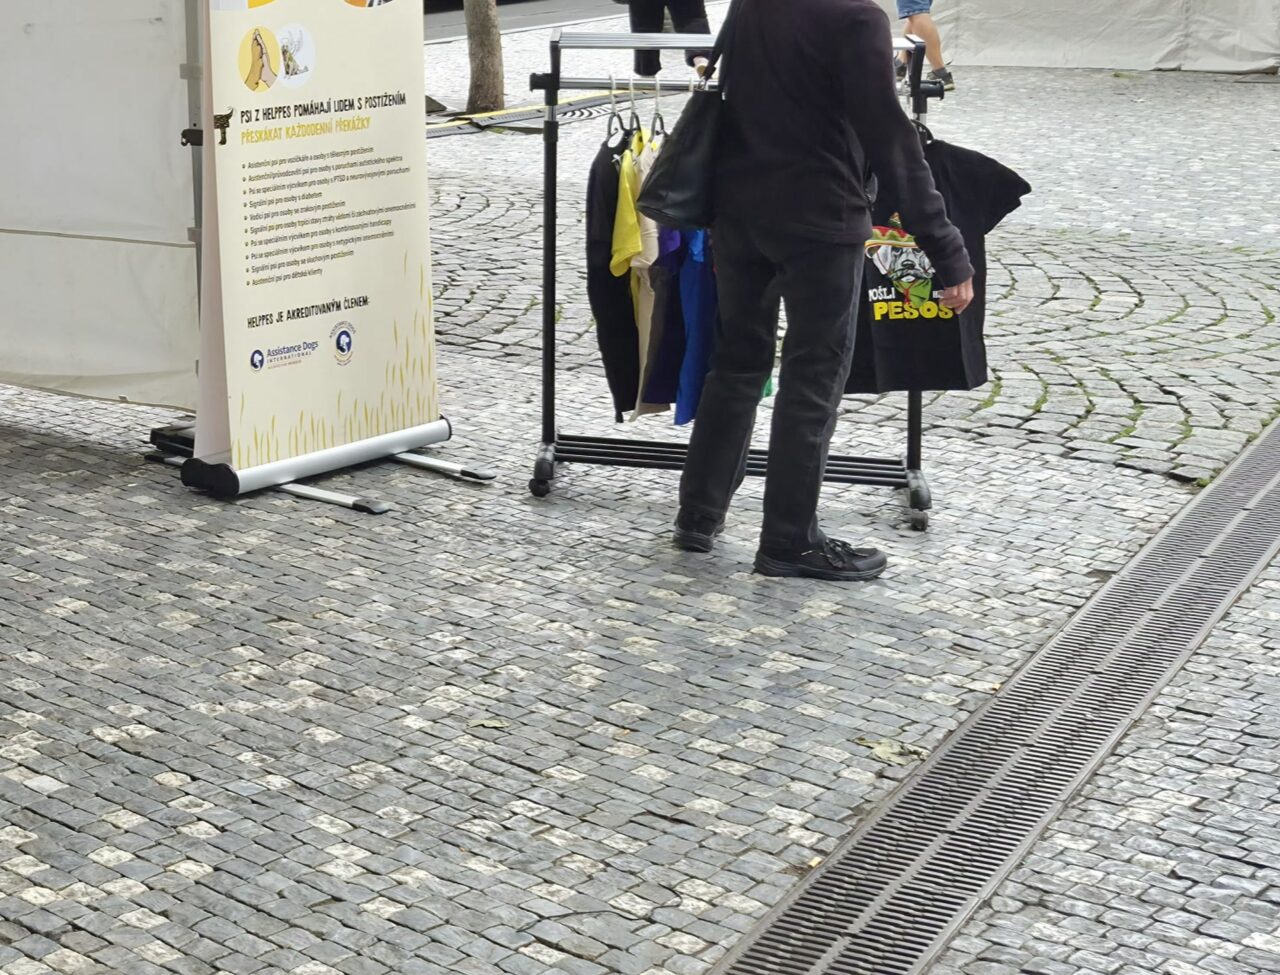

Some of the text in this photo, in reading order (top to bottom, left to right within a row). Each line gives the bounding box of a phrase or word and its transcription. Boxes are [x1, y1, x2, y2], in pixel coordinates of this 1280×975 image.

[240, 90, 406, 124] PSI Z HELPPES POMÁHAJÍ LIDEM S POSTIŽENÍM
[241, 116, 371, 145] PŘESKÁKAT KAŽDODENNÍ PŘEKÁŽKY
[247, 295, 370, 328] HELPPES JE AKREDITOVANÝM ČLENEM:
[873, 301, 954, 321] PESOS
[267, 341, 319, 357] Assistance Dogs
